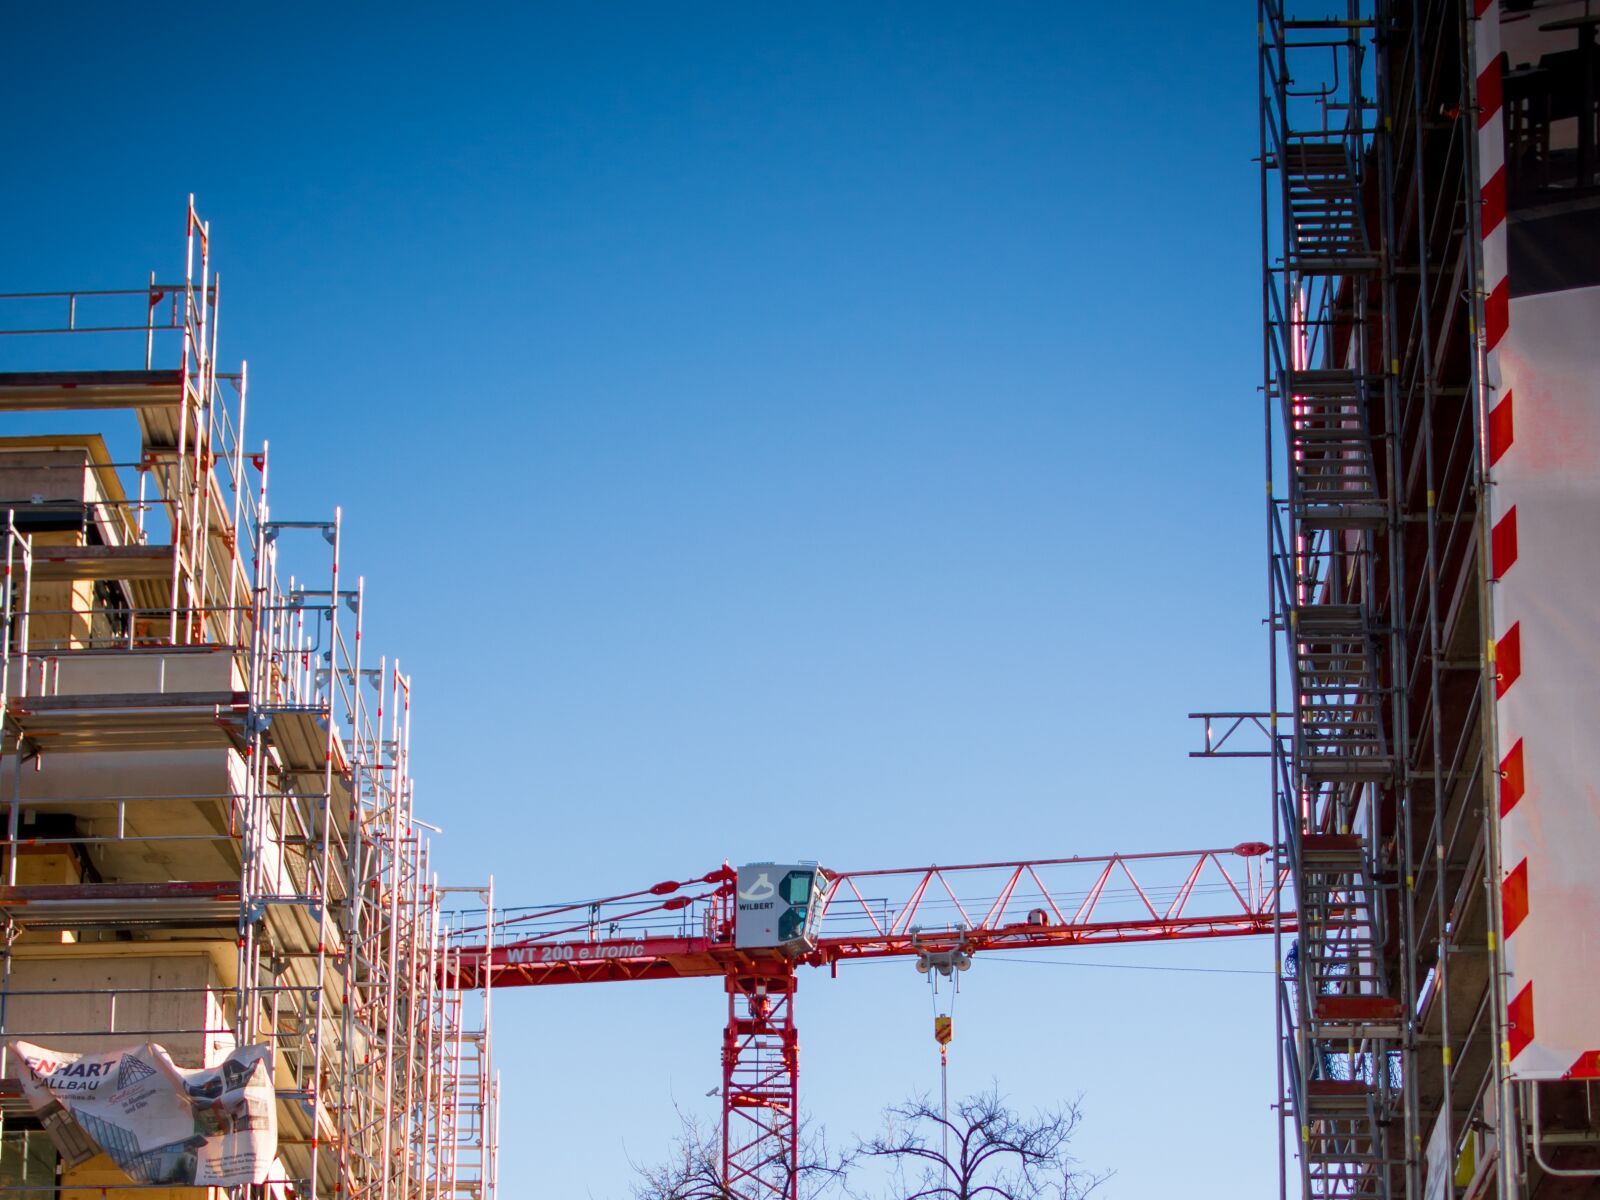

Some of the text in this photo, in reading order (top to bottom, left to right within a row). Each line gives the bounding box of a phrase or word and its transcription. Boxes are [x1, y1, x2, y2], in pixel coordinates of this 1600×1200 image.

[738, 902, 774, 910] WILBERT
[507, 943, 645, 963] WT 200 e.tronic
